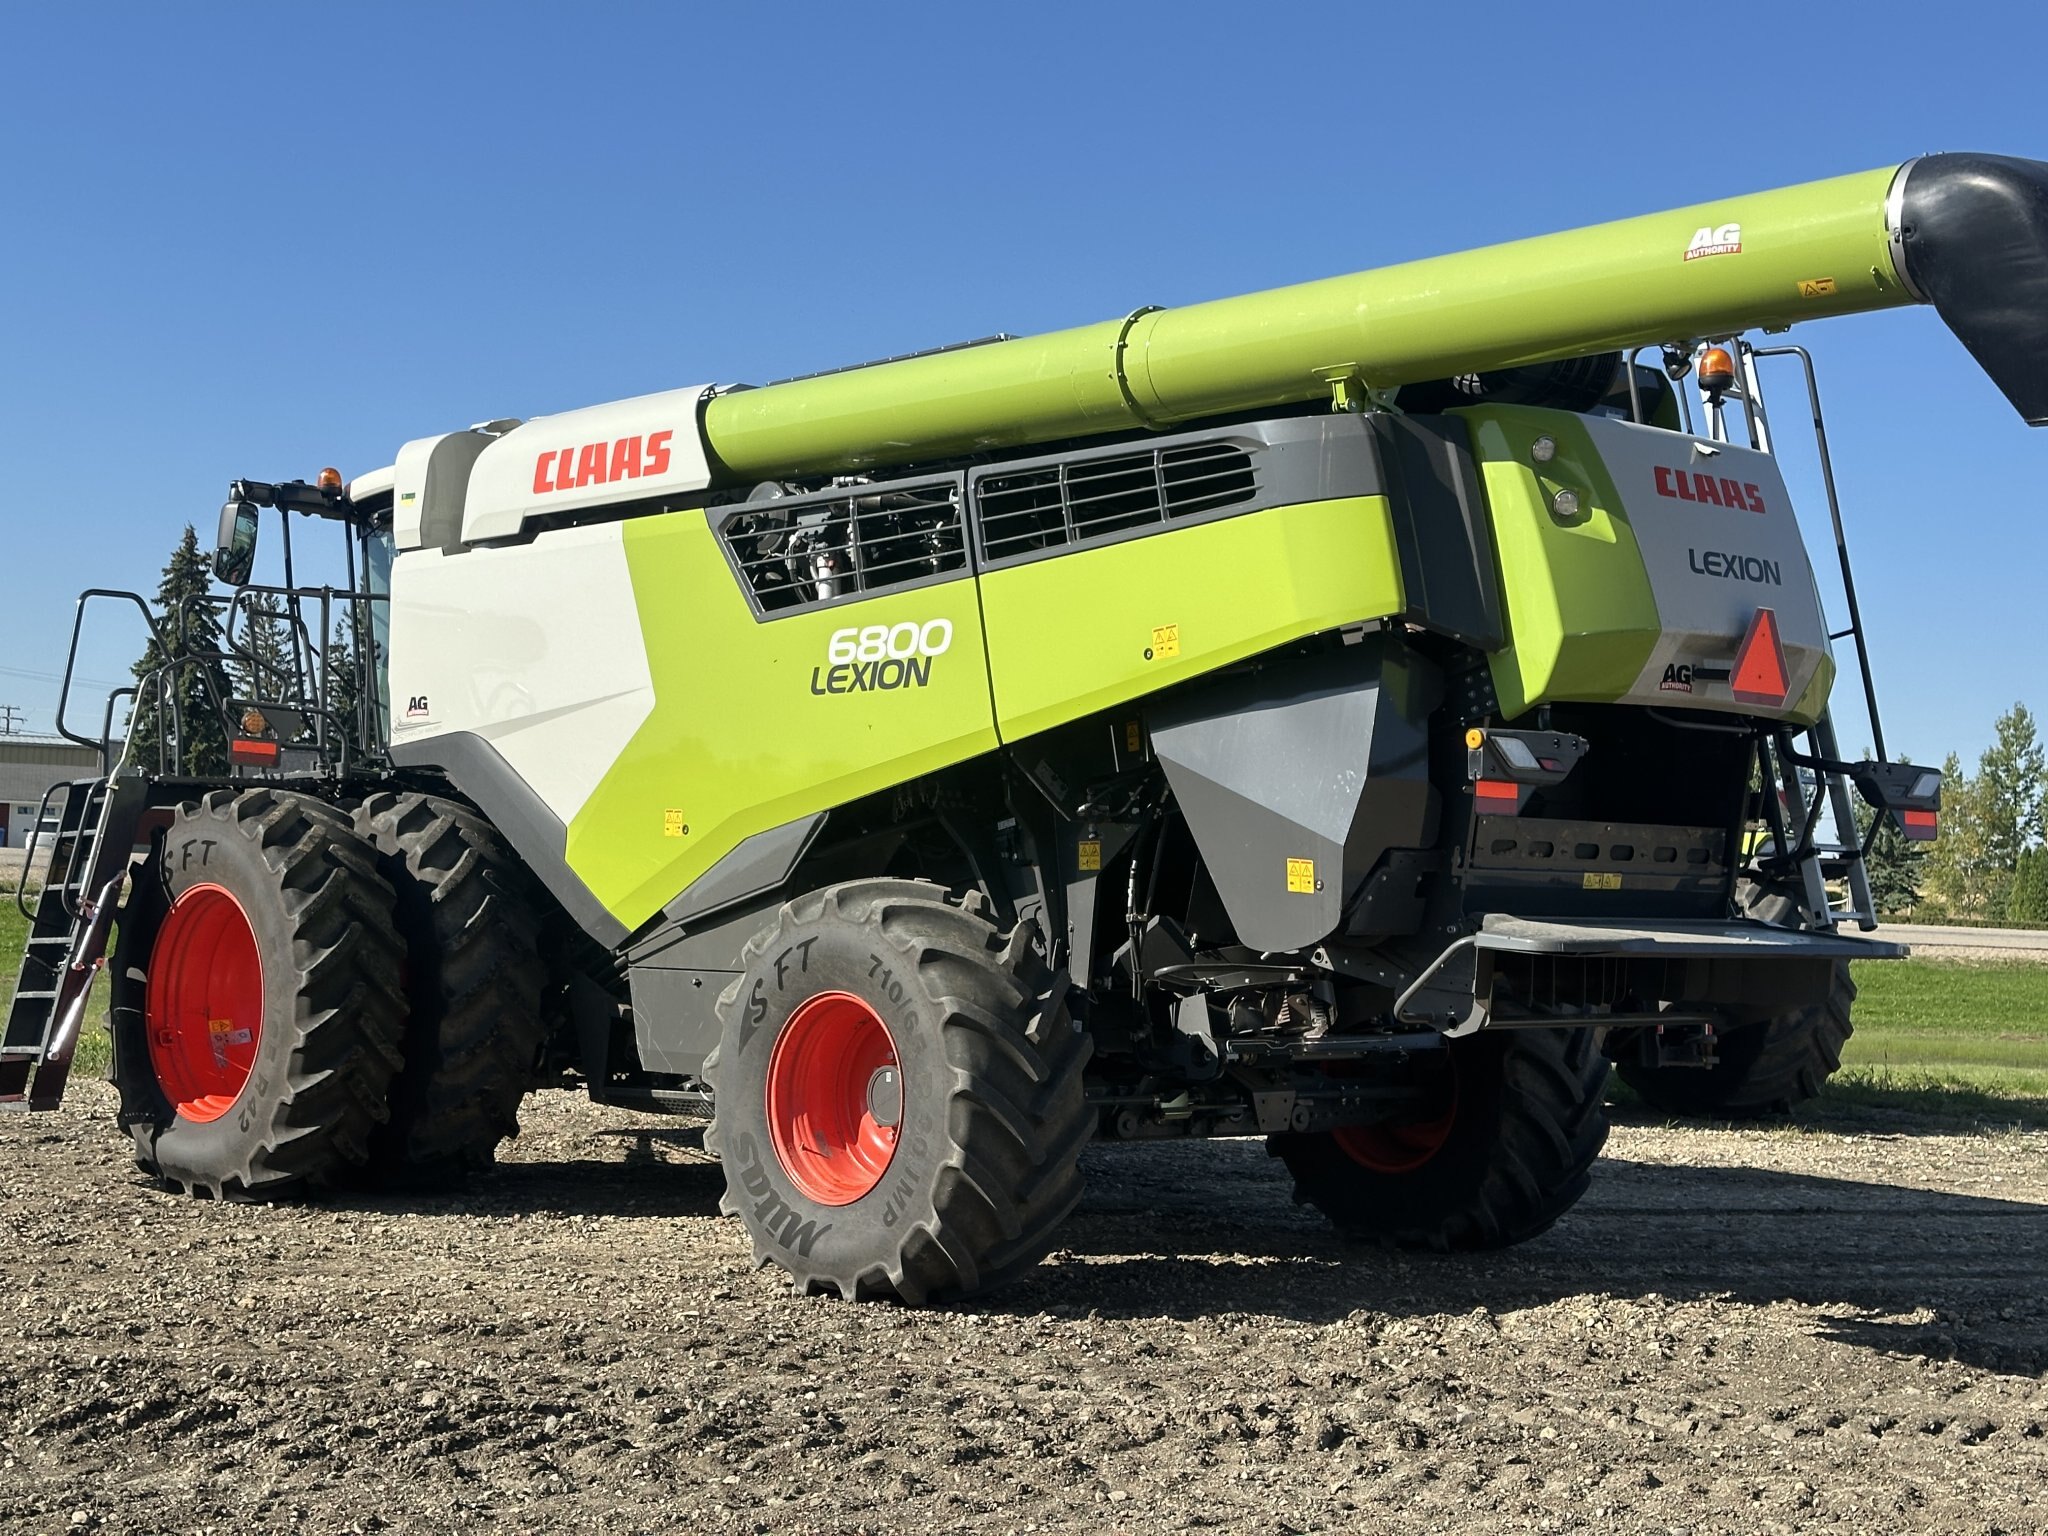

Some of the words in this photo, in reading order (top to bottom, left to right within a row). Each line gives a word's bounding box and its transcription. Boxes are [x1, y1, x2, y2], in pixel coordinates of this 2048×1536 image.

[1686, 243, 1740, 260] AUTHORITY
[1687, 222, 1741, 250] AG
[533, 429, 674, 494] CLAAS
[1653, 465, 1766, 514] CLAAS
[1688, 548, 1782, 586] LEXION
[828, 618, 953, 665] 6800
[811, 656, 932, 695] LEXION
[1662, 663, 1692, 684] AG
[408, 695, 428, 711] AG
[732, 1131, 833, 1258] Mitas
